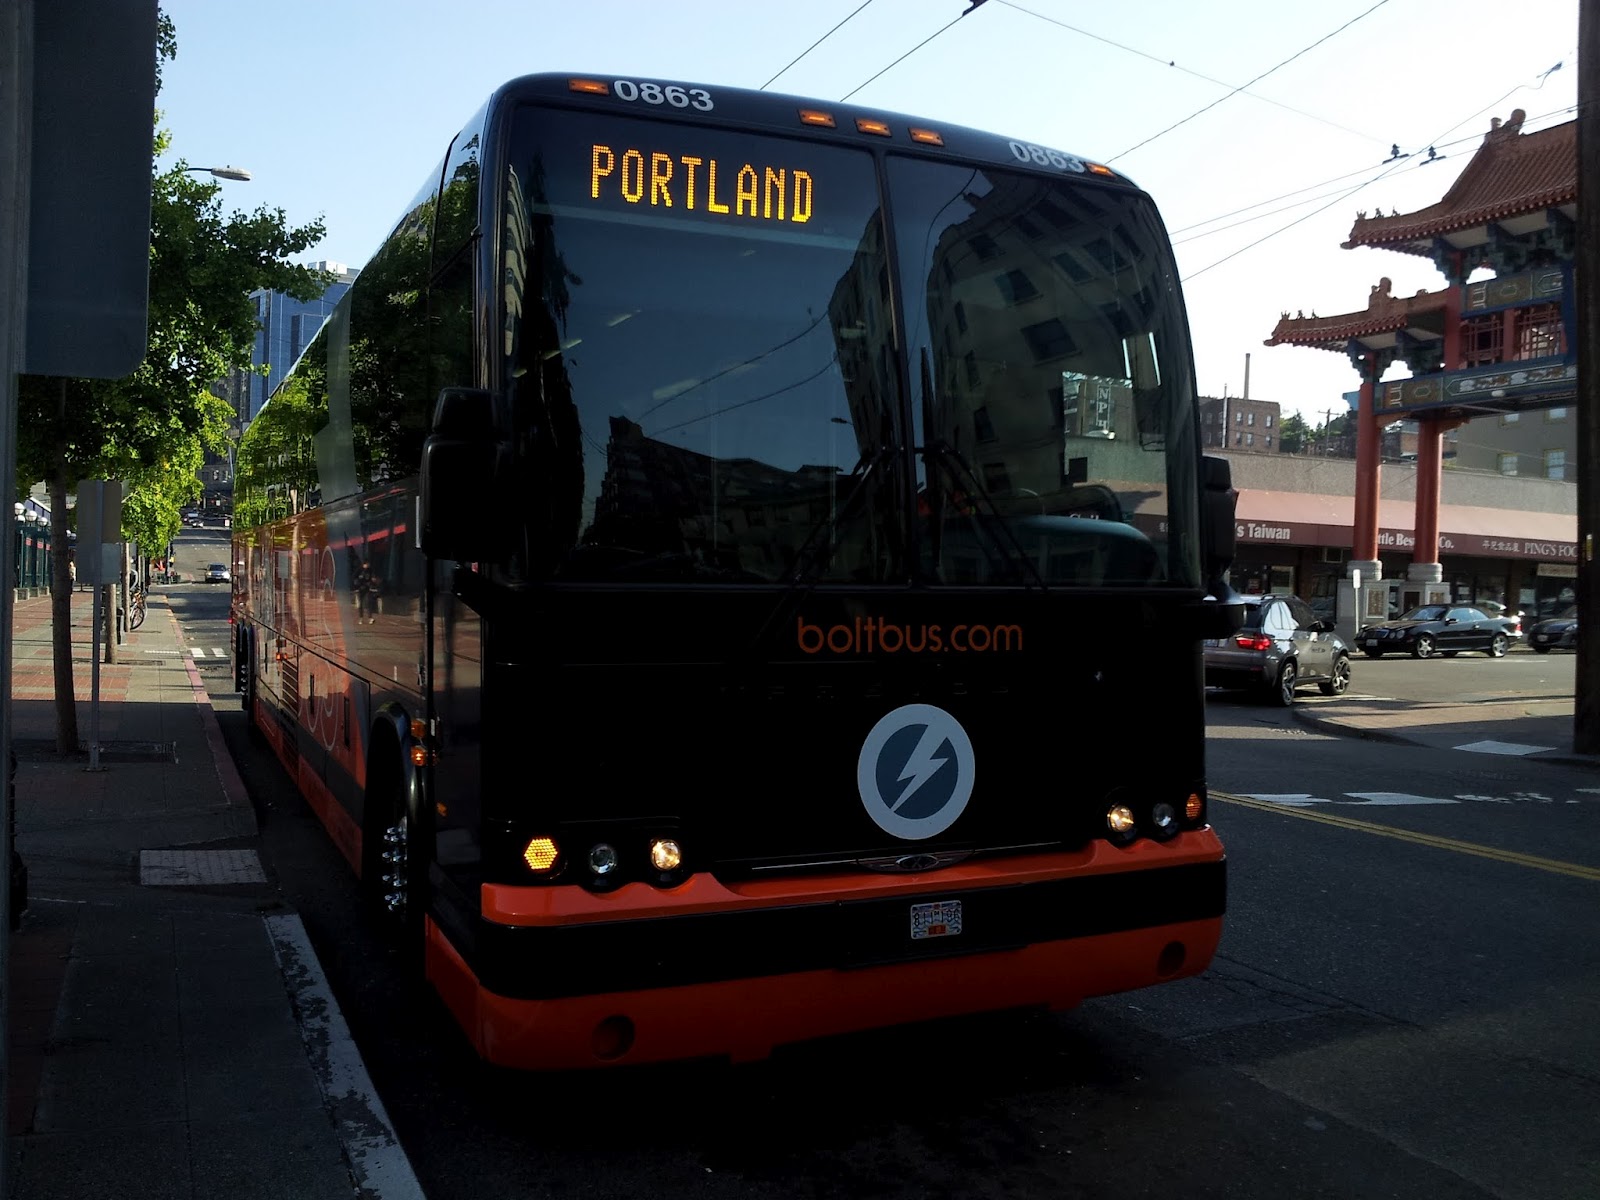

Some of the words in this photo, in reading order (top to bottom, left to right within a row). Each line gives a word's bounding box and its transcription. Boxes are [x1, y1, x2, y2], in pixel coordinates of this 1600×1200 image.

[613, 79, 715, 112] 0863
[1008, 141, 1086, 174] 0863
[590, 143, 814, 224] PORTLAND
[1247, 523, 1291, 540] Taiwan
[1377, 532, 1395, 545] ttle
[796, 615, 1024, 655] boltbus.com
